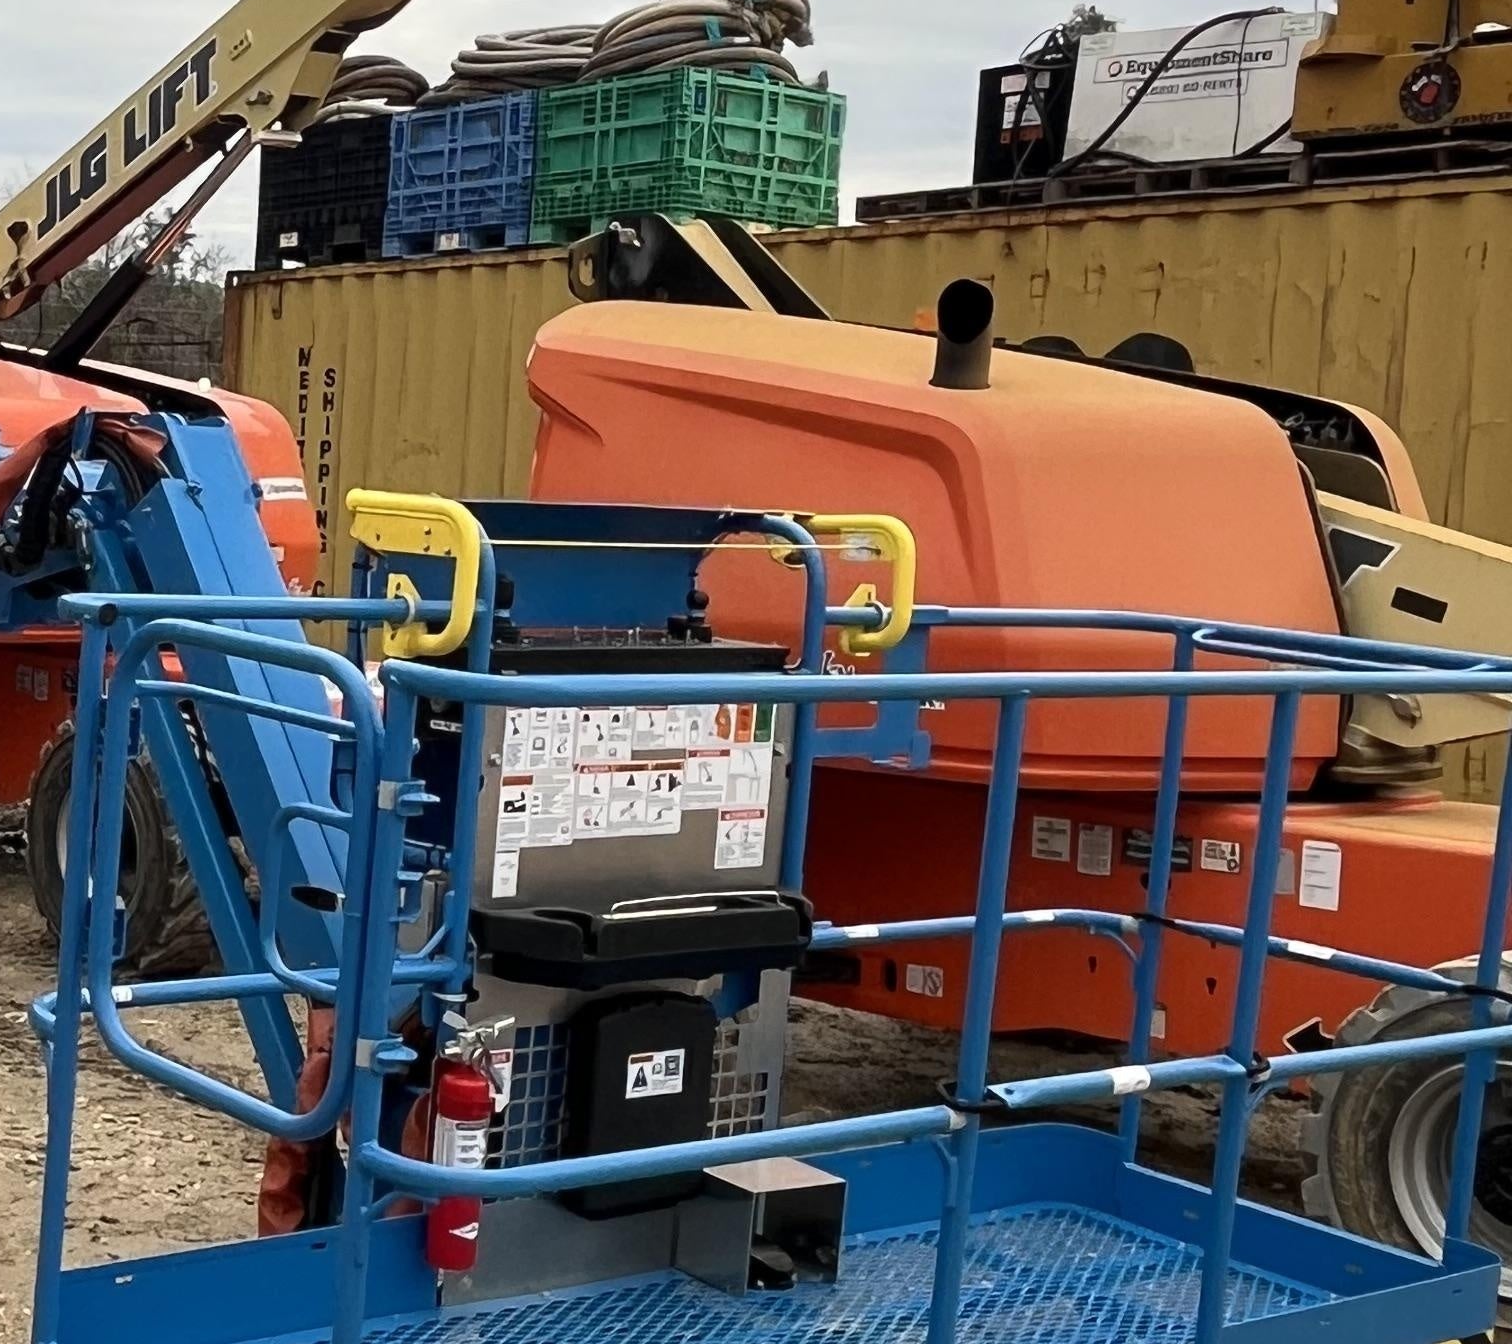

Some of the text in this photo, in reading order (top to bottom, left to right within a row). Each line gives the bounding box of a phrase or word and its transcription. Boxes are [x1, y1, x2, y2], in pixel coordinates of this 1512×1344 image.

[1125, 49, 1273, 76] EqupmentShare
[37, 37, 217, 240] JLG LIFT
